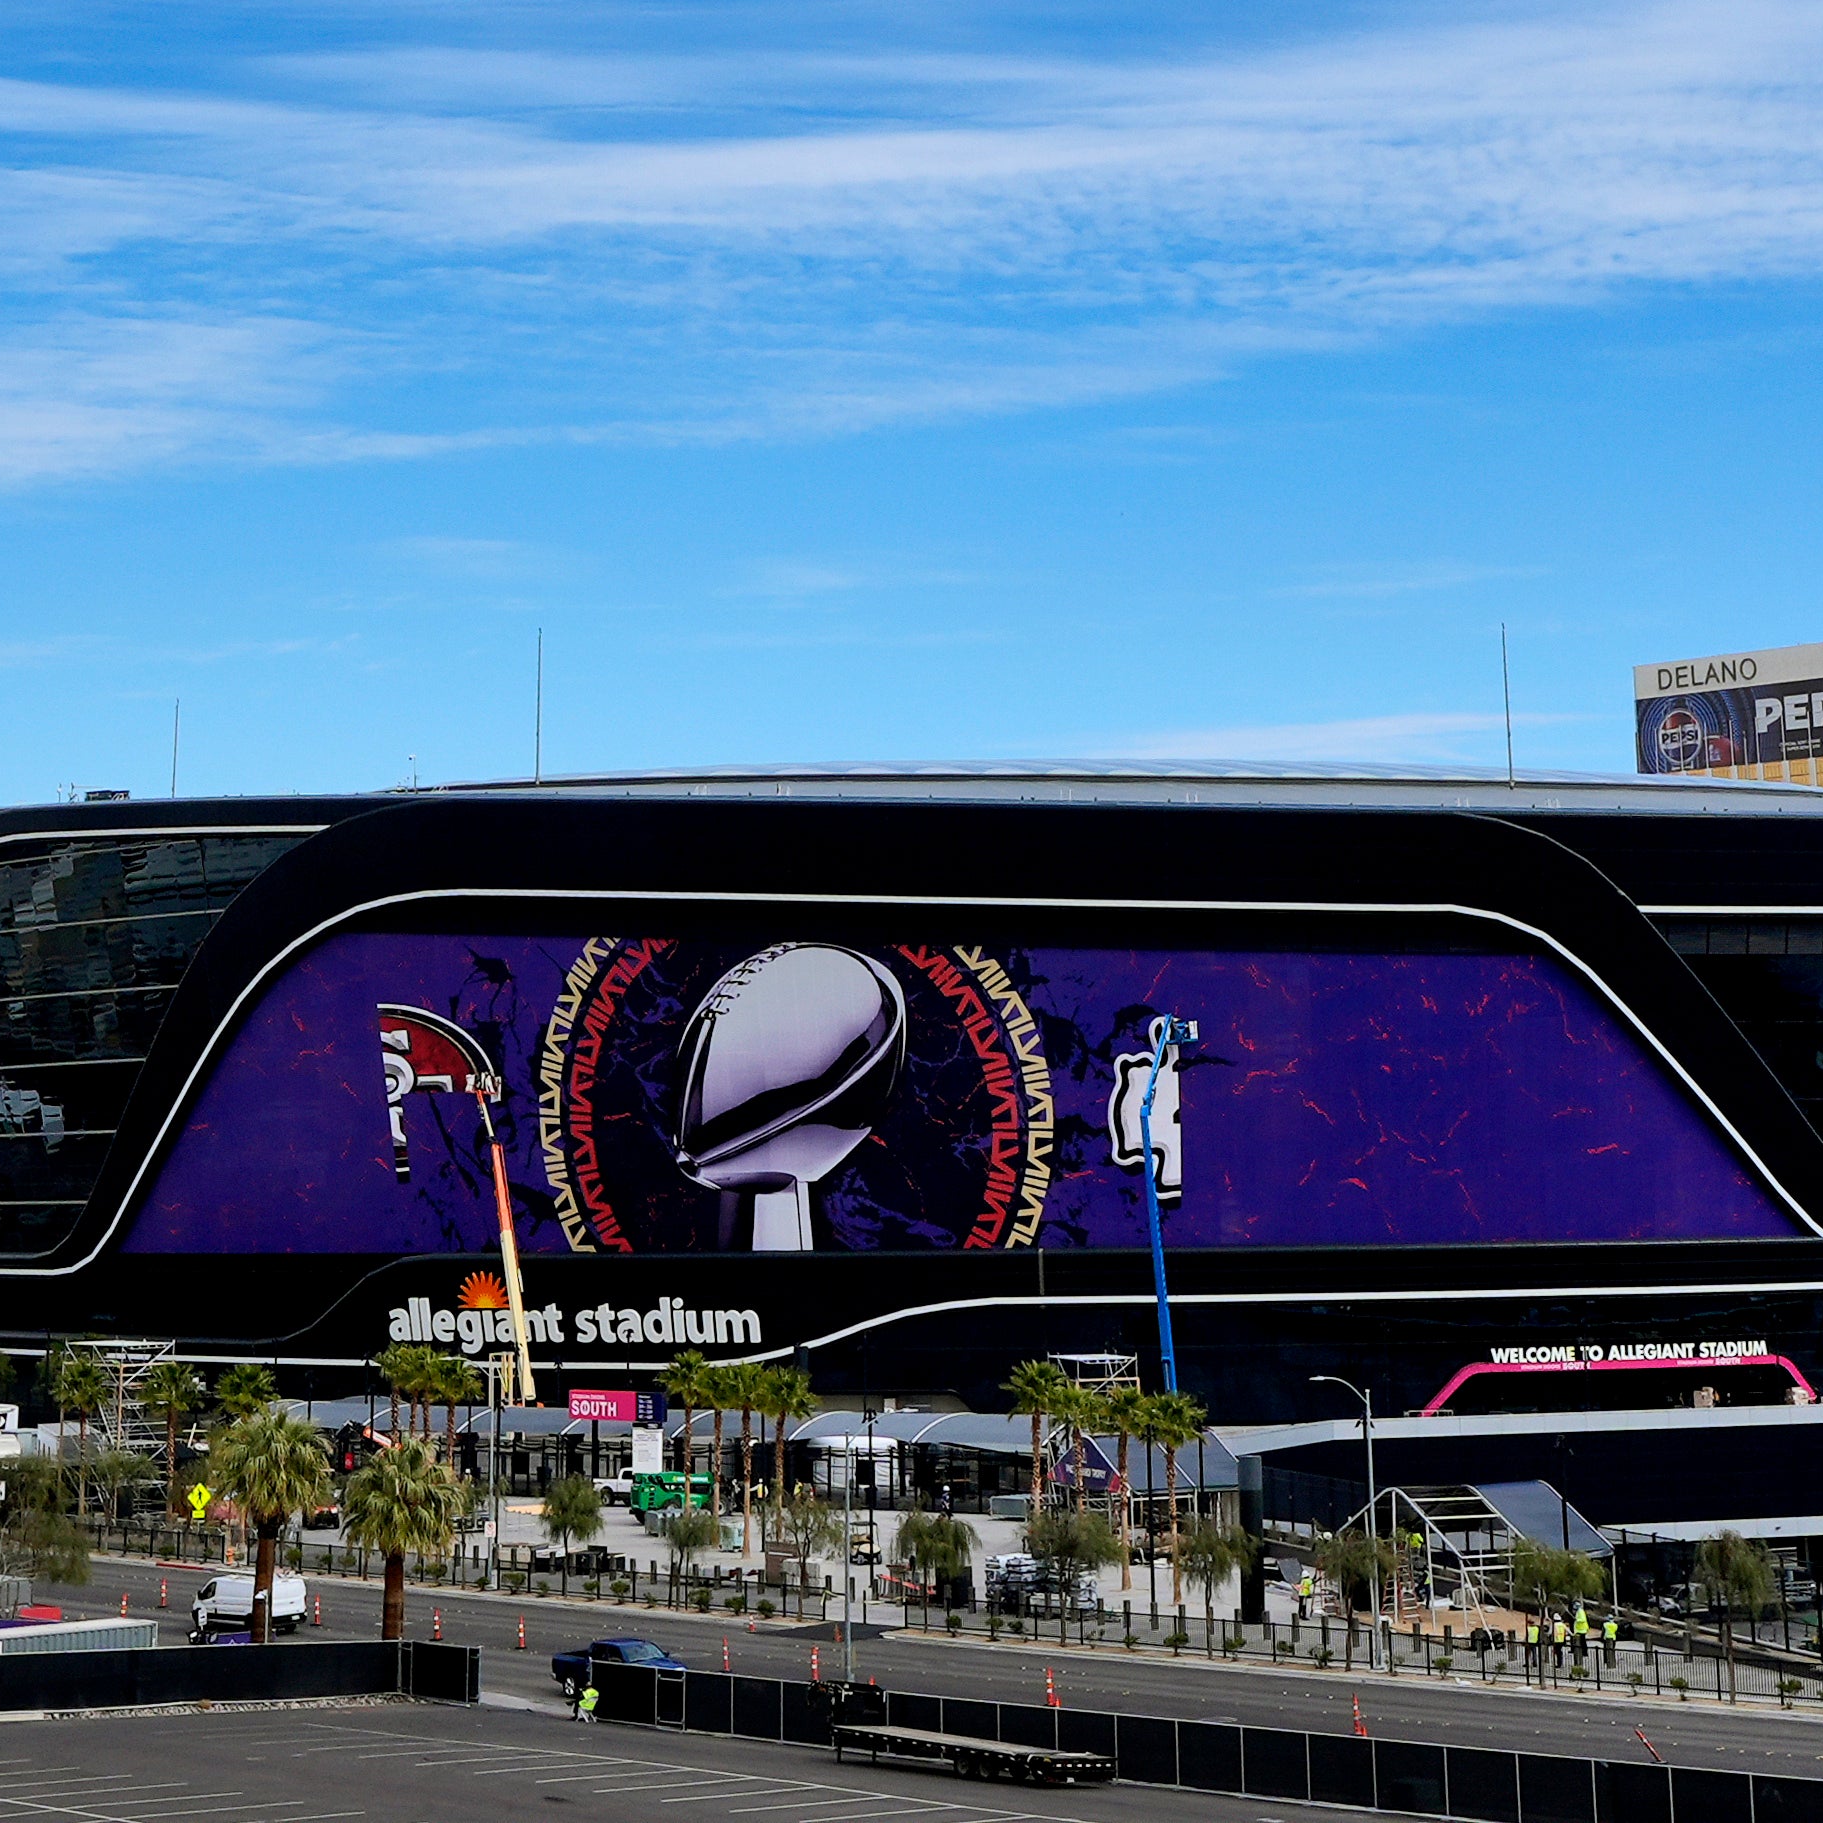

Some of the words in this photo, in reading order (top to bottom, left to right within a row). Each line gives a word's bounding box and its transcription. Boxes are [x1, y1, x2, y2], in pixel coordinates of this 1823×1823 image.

[1658, 658, 1757, 690] DELANO
[1662, 731, 1698, 744] PEPSI
[388, 1297, 565, 1354] allegiant
[575, 1297, 762, 1344] stadium
[1490, 1346, 1576, 1363] WELCOME
[1580, 1345, 1604, 1361] TO
[1608, 1343, 1695, 1360] ALLEGIANT
[1699, 1340, 1768, 1358] STADIUM
[571, 1400, 617, 1417] SOUTH
